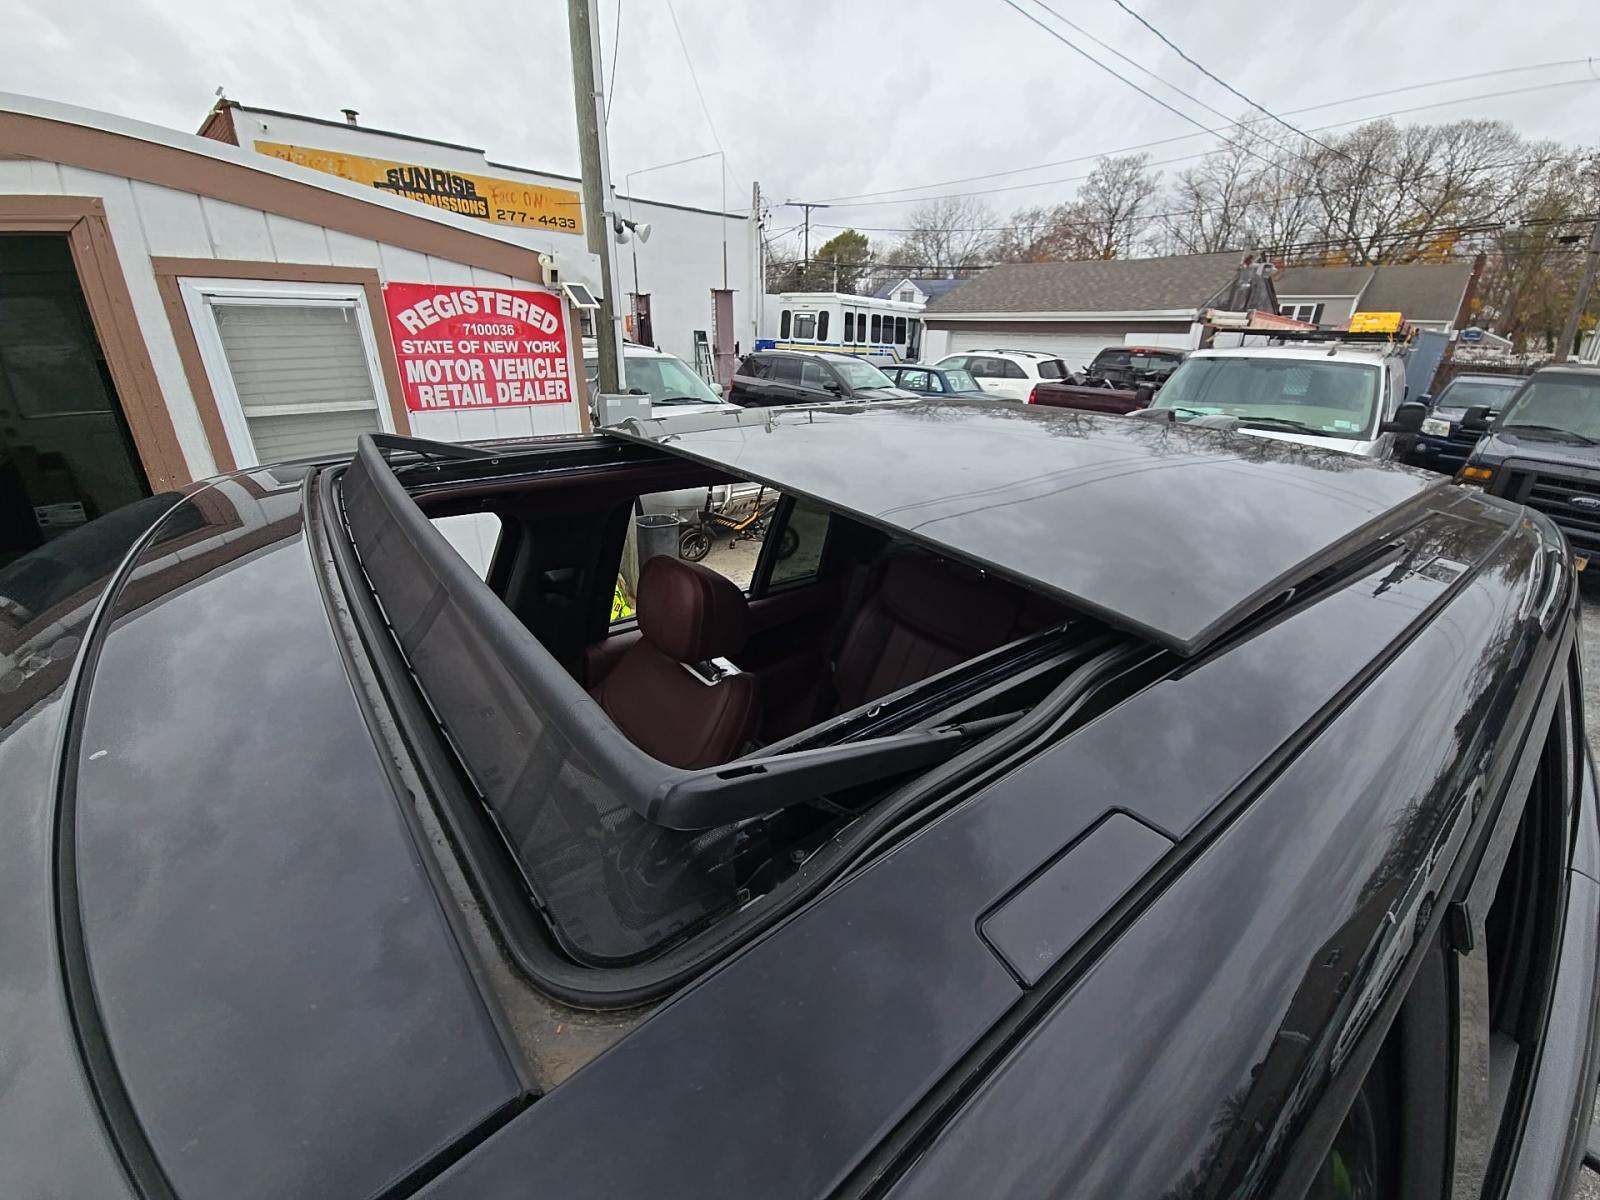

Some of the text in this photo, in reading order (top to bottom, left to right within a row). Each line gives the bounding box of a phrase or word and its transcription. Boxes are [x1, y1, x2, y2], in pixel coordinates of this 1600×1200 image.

[386, 167, 477, 199] SUNRISE
[381, 187, 487, 216] NSMISSIONS
[496, 209, 576, 229] 277-4433
[396, 290, 559, 336] REGISTERED
[463, 323, 515, 336] 7100036
[402, 340, 562, 354] STATE OF NEW YORK
[404, 357, 567, 383] MOTOR VEHICLE
[418, 379, 567, 408] RETAIL DEALER
